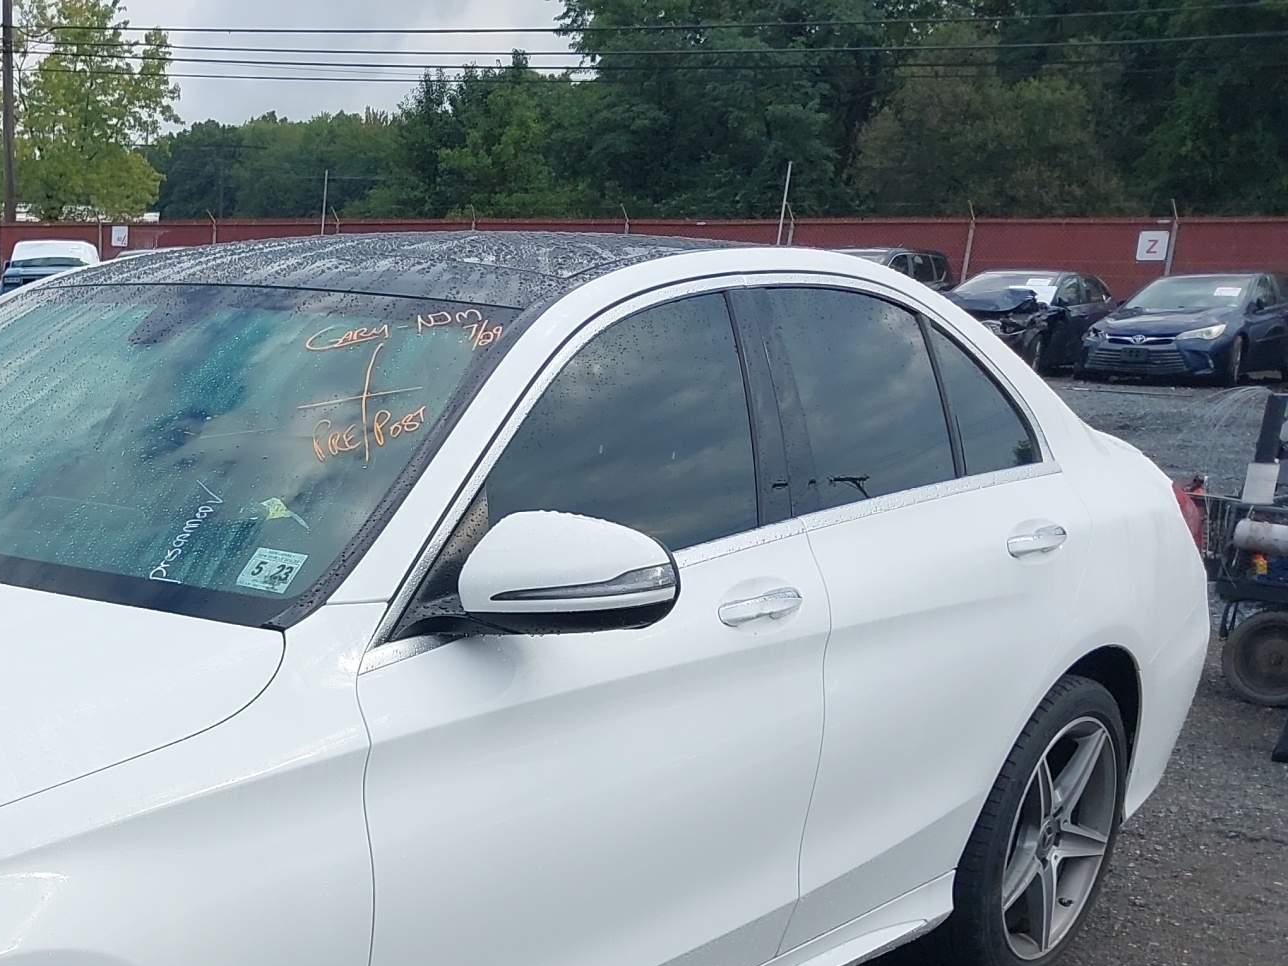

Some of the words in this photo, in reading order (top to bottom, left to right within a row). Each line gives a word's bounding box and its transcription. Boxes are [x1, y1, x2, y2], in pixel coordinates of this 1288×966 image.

[1145, 239, 1160, 254] Z
[250, 560, 269, 577] 5
[269, 563, 295, 582] 23
